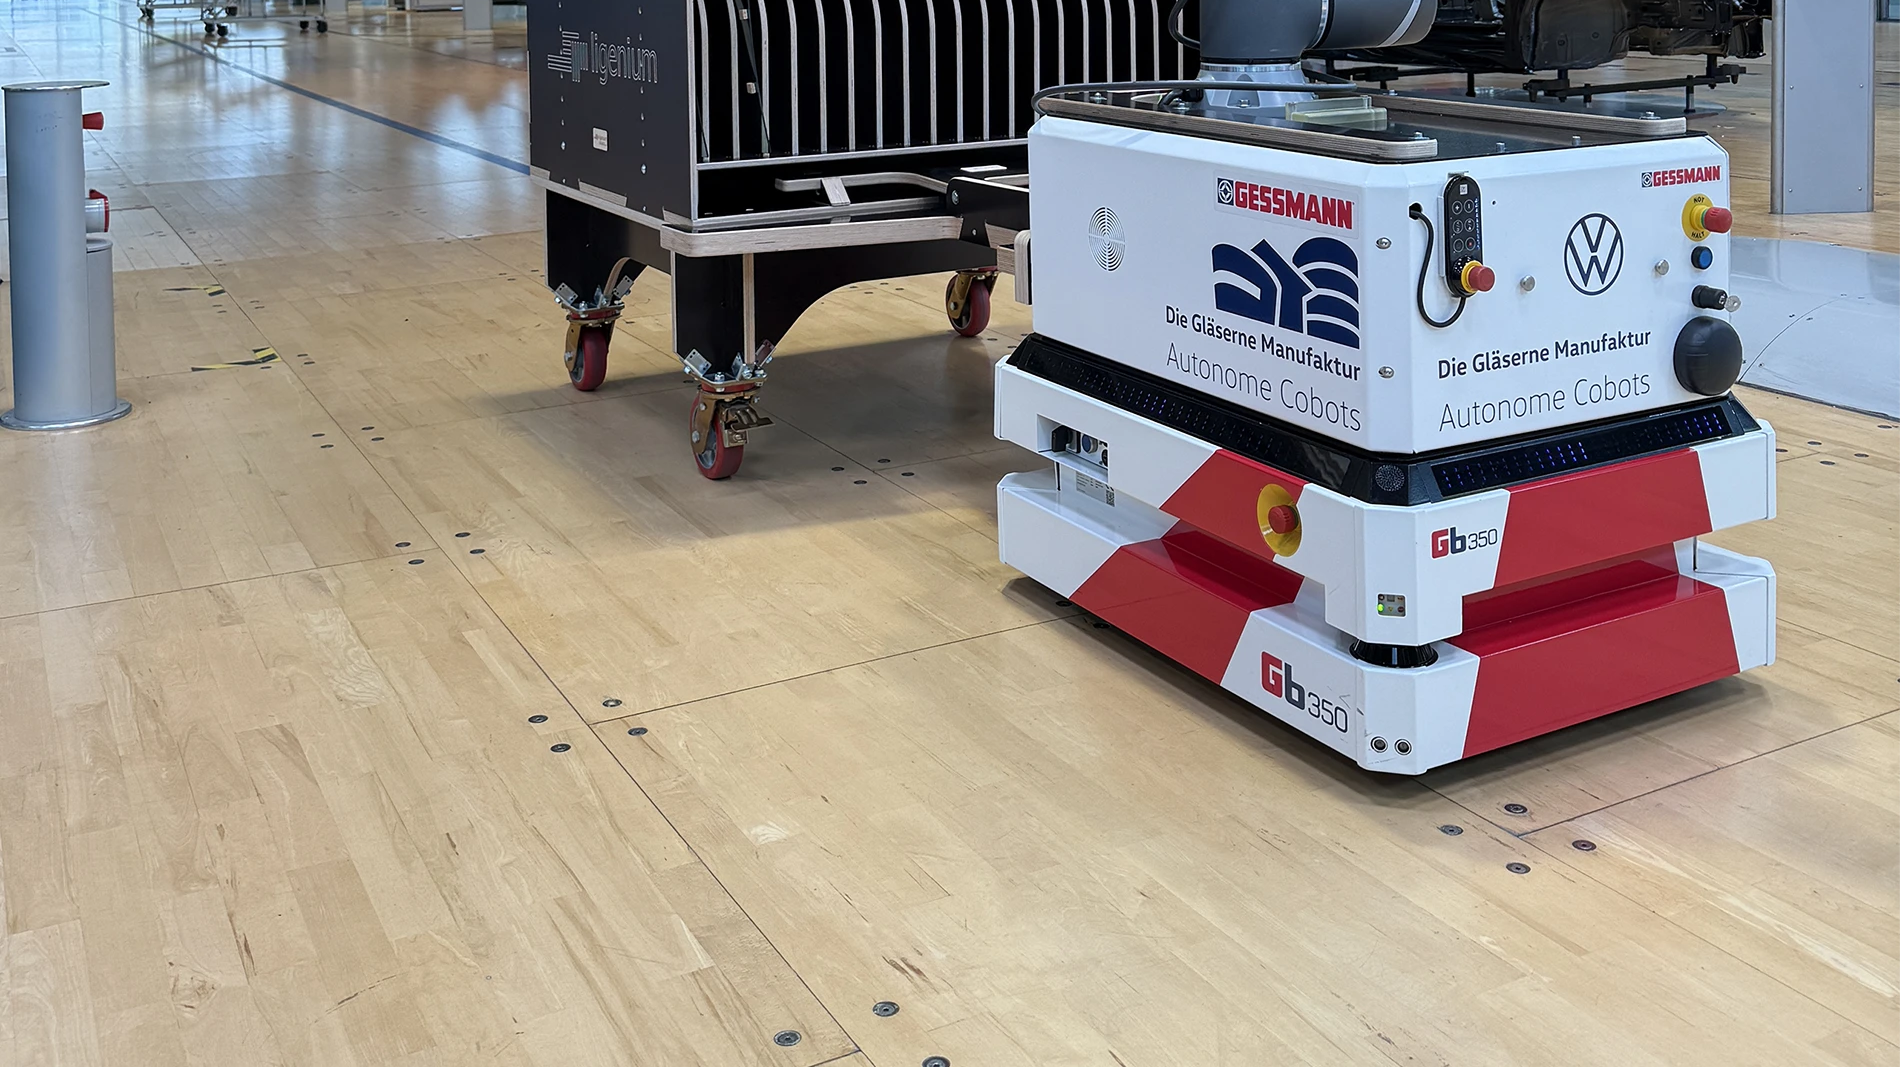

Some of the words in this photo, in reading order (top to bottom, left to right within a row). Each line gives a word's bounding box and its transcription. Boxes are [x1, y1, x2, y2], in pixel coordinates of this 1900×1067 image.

[590, 31, 658, 86] ligenium
[1653, 165, 1721, 187] GESSMANN
[1234, 181, 1353, 230] GESSMANN
[1165, 304, 1188, 330] Die
[1191, 313, 1257, 350] Gläserne
[1261, 333, 1361, 381] Manufaktur
[1438, 358, 1467, 379] Die
[1472, 346, 1549, 374] Gläserne
[1554, 330, 1651, 358] Manufaktur
[1166, 342, 1272, 402] Autonome
[1279, 378, 1361, 432] Cobots
[1439, 389, 1565, 432] Autonome
[1573, 372, 1651, 406] Cobots
